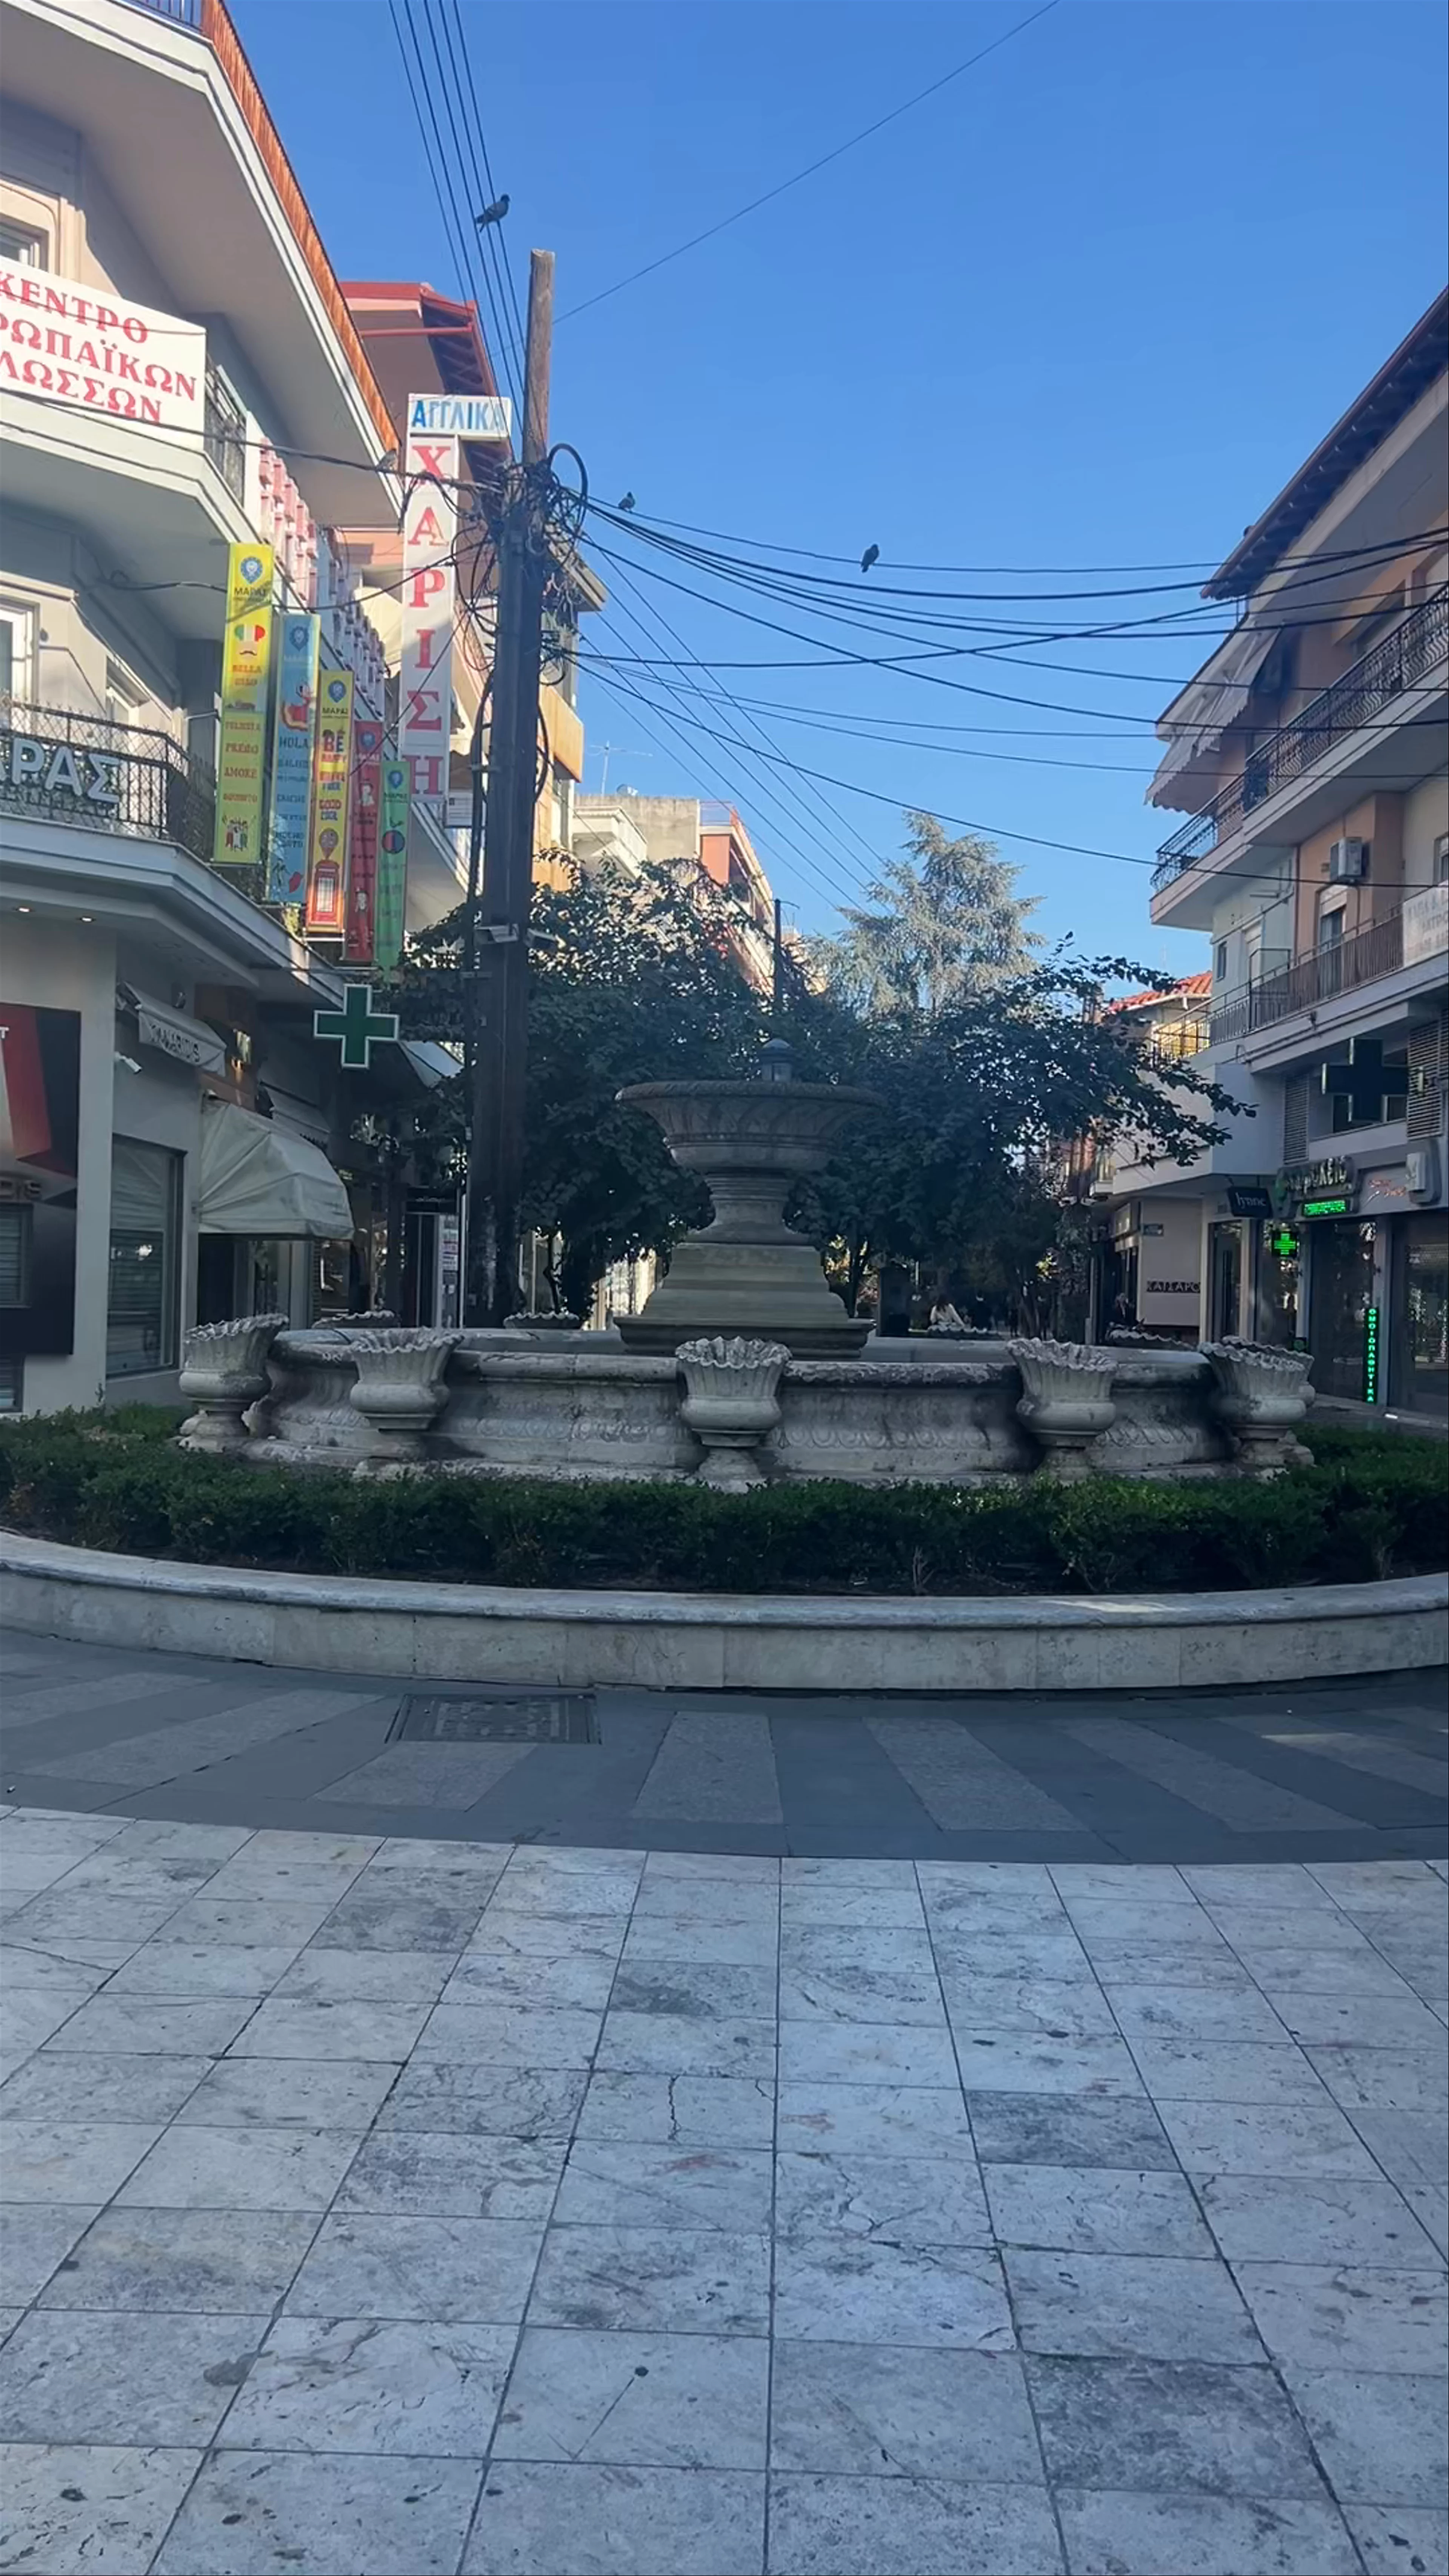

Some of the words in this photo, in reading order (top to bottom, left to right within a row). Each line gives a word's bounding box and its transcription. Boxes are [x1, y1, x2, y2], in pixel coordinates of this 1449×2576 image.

[412, 400, 505, 431] ΑΓΓΛΙΚΑ
[402, 445, 451, 796] ΧΑΡΙΣΗ
[279, 736, 309, 749] HOLA
[323, 733, 345, 752] BE
